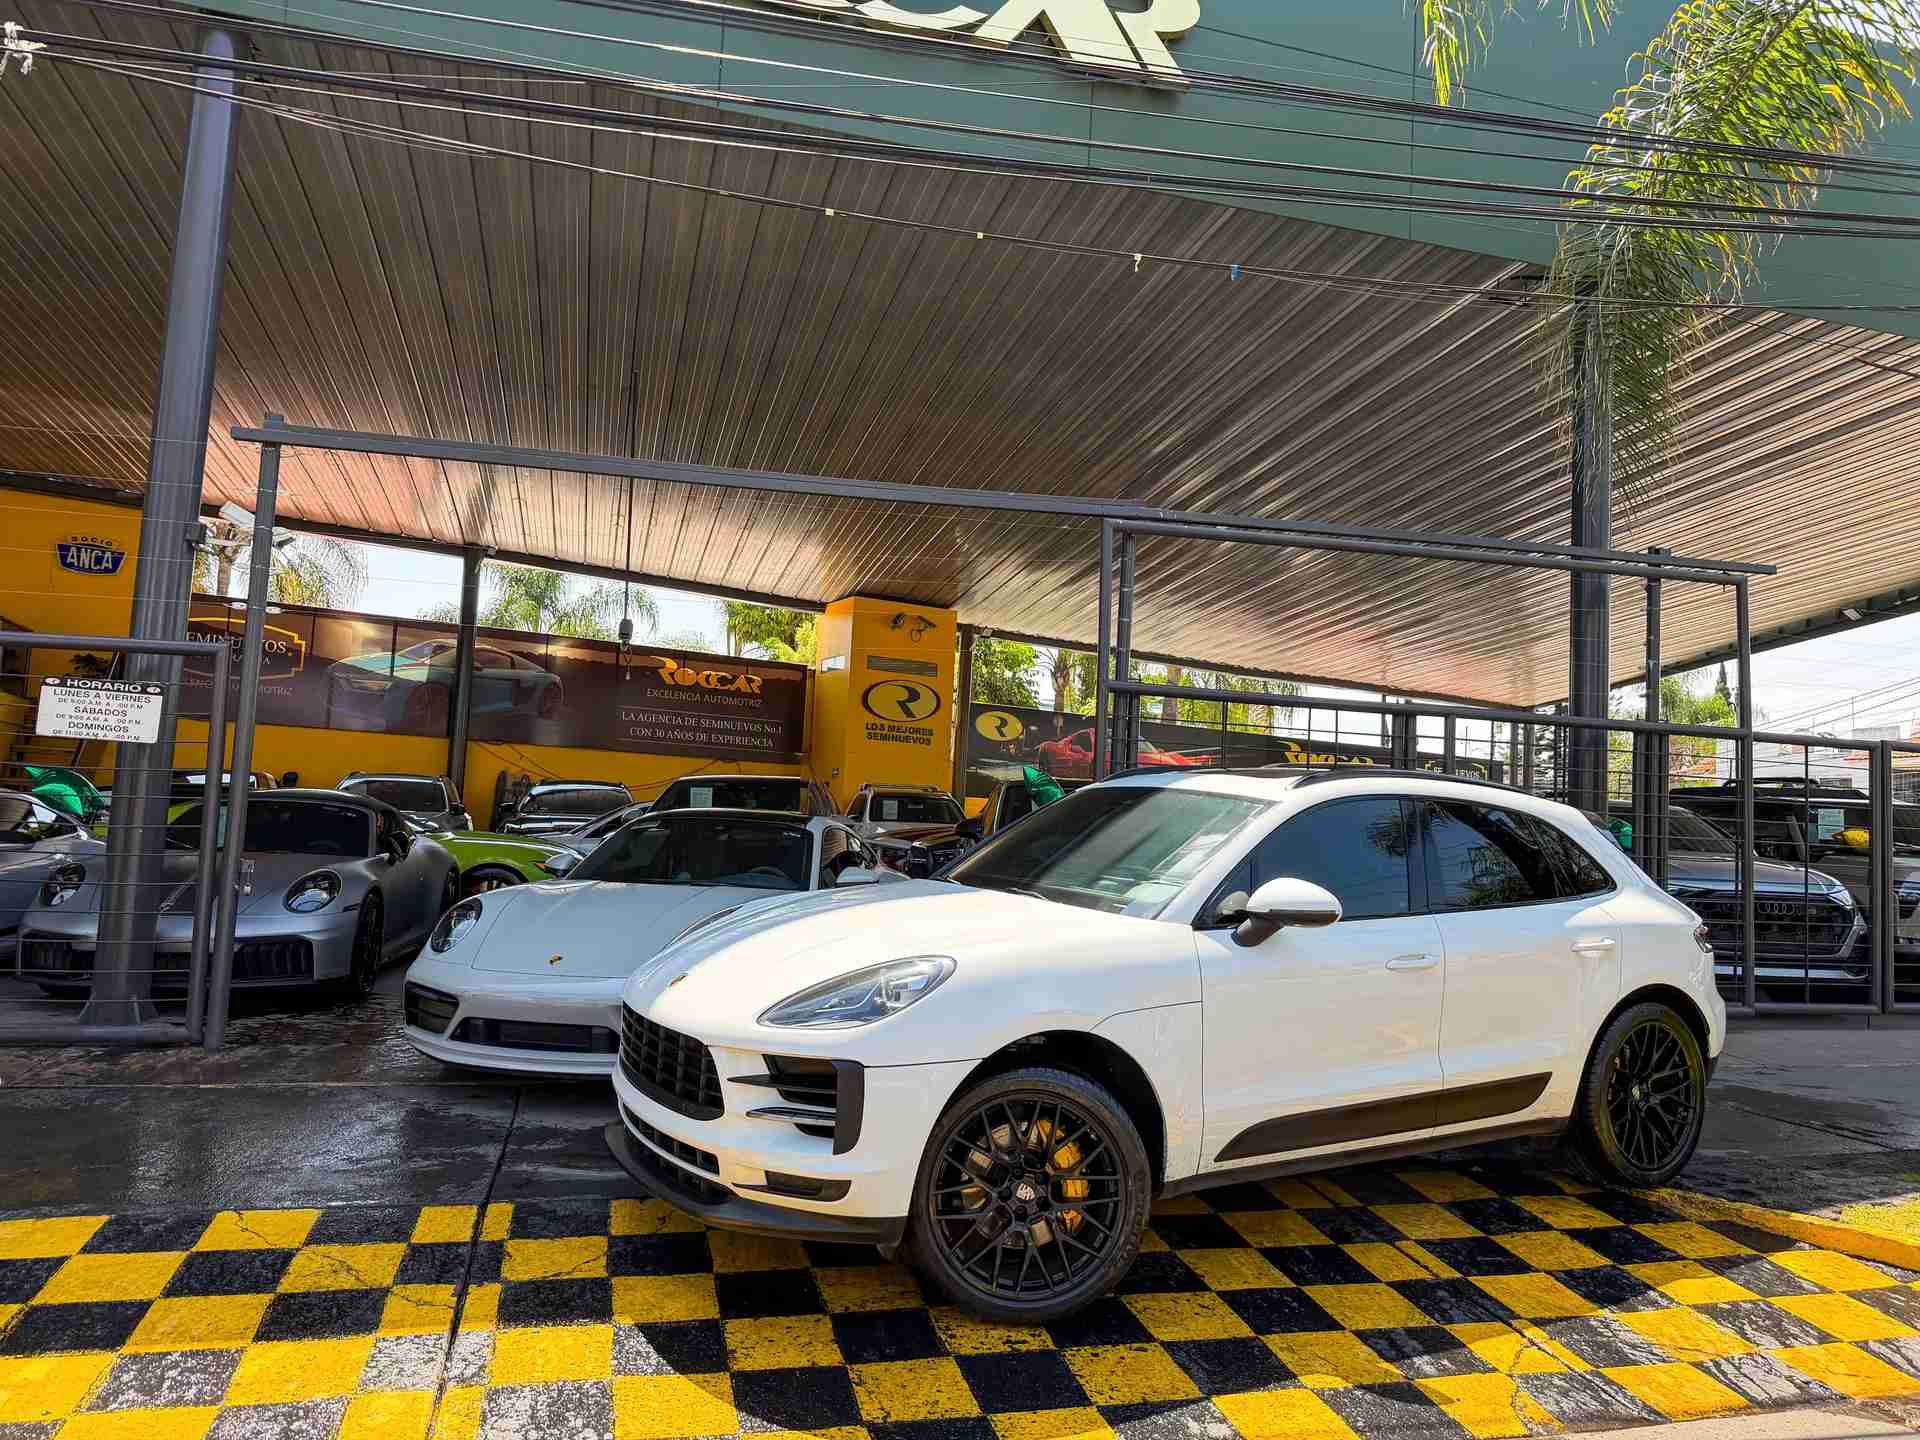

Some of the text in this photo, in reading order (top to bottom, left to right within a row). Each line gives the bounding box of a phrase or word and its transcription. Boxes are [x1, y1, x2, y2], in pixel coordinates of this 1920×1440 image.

[71, 535, 113, 547] SOCIO
[66, 547, 113, 570] ANCA
[66, 678, 142, 693] HORARIO
[53, 688, 152, 704] LUNES A VIERNES
[647, 688, 762, 708] EXCELENCIA AUTOMOTRIZ
[67, 721, 129, 733] DOMINGOS
[622, 711, 635, 721] LA
[634, 712, 682, 725] AGENCIA
[684, 716, 698, 727] DE
[700, 718, 762, 732] SEMINUEVOS
[865, 721, 934, 736] LOS MEJORES
[629, 727, 774, 748] CON 30 AÑOS DE EXPERIENCIA
[865, 732, 932, 746] SEMINUEVOS
